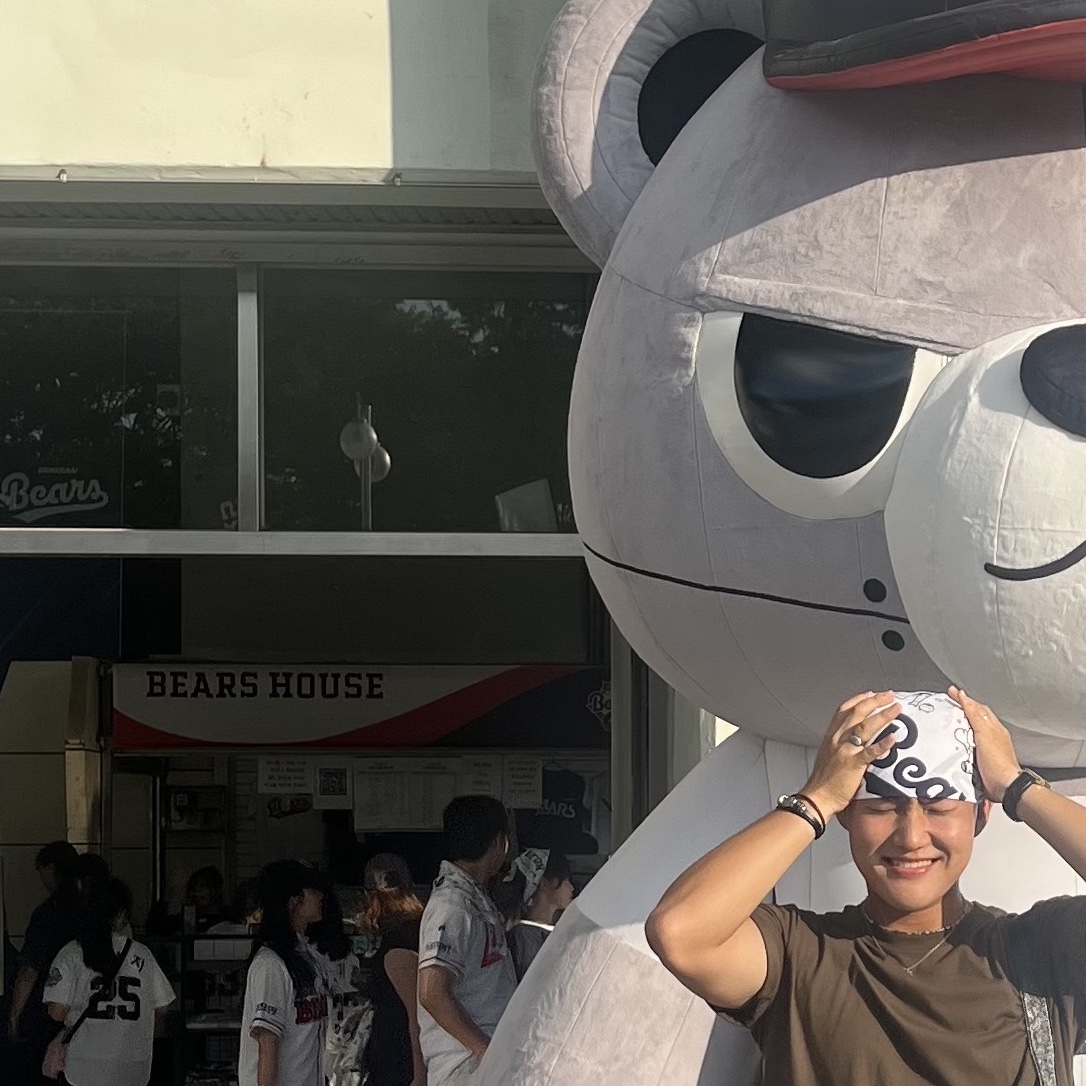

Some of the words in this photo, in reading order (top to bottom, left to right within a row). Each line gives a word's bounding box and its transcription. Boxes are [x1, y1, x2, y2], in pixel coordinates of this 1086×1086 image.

[0, 472, 108, 523] Bears
[147, 671, 258, 698] BEARS
[269, 672, 384, 699] HOUSE
[864, 712, 967, 803] Bea
[86, 976, 141, 1021] 25
